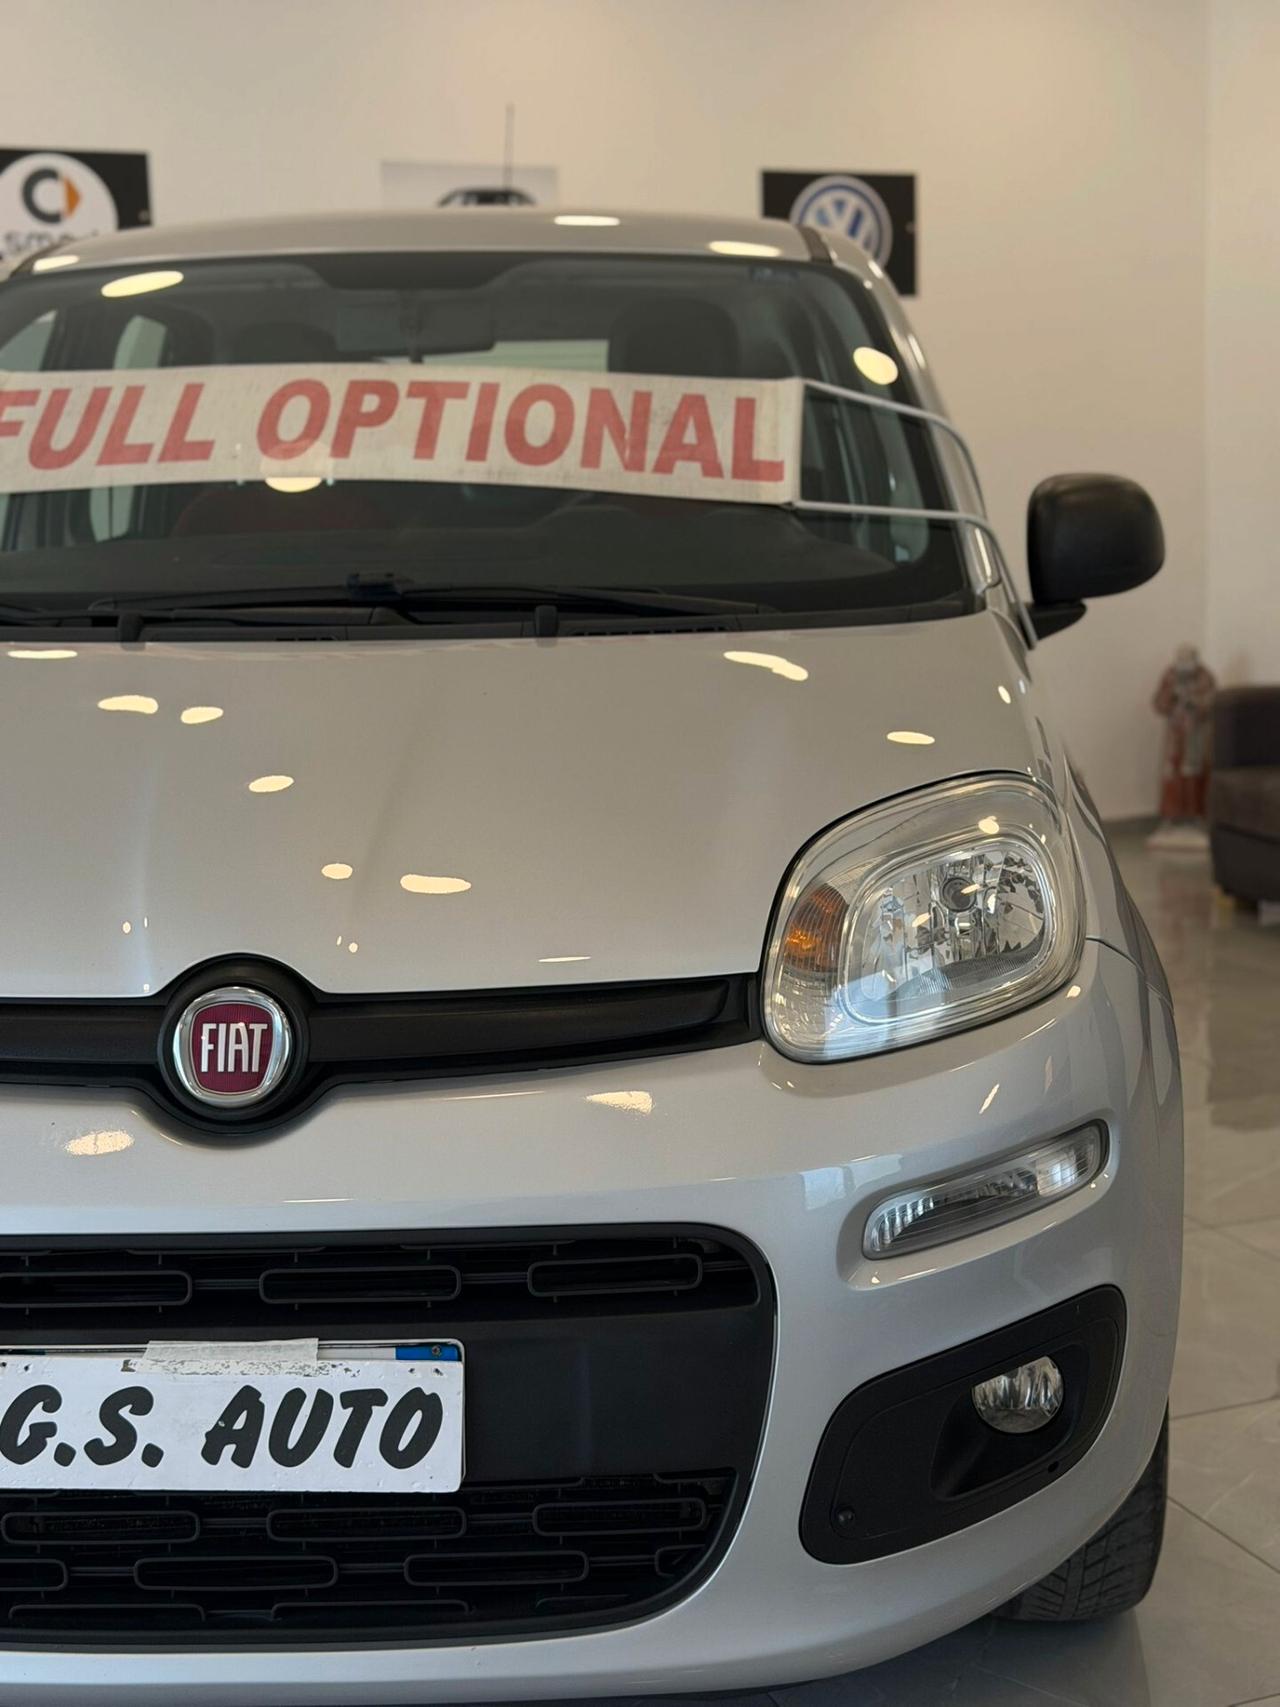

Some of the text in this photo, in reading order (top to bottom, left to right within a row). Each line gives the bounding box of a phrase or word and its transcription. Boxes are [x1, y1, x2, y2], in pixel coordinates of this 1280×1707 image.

[0, 378, 786, 484] FULL OPTIONAL
[200, 1022, 268, 1073] FIAT
[0, 1385, 444, 1469] G.S. AUTO
